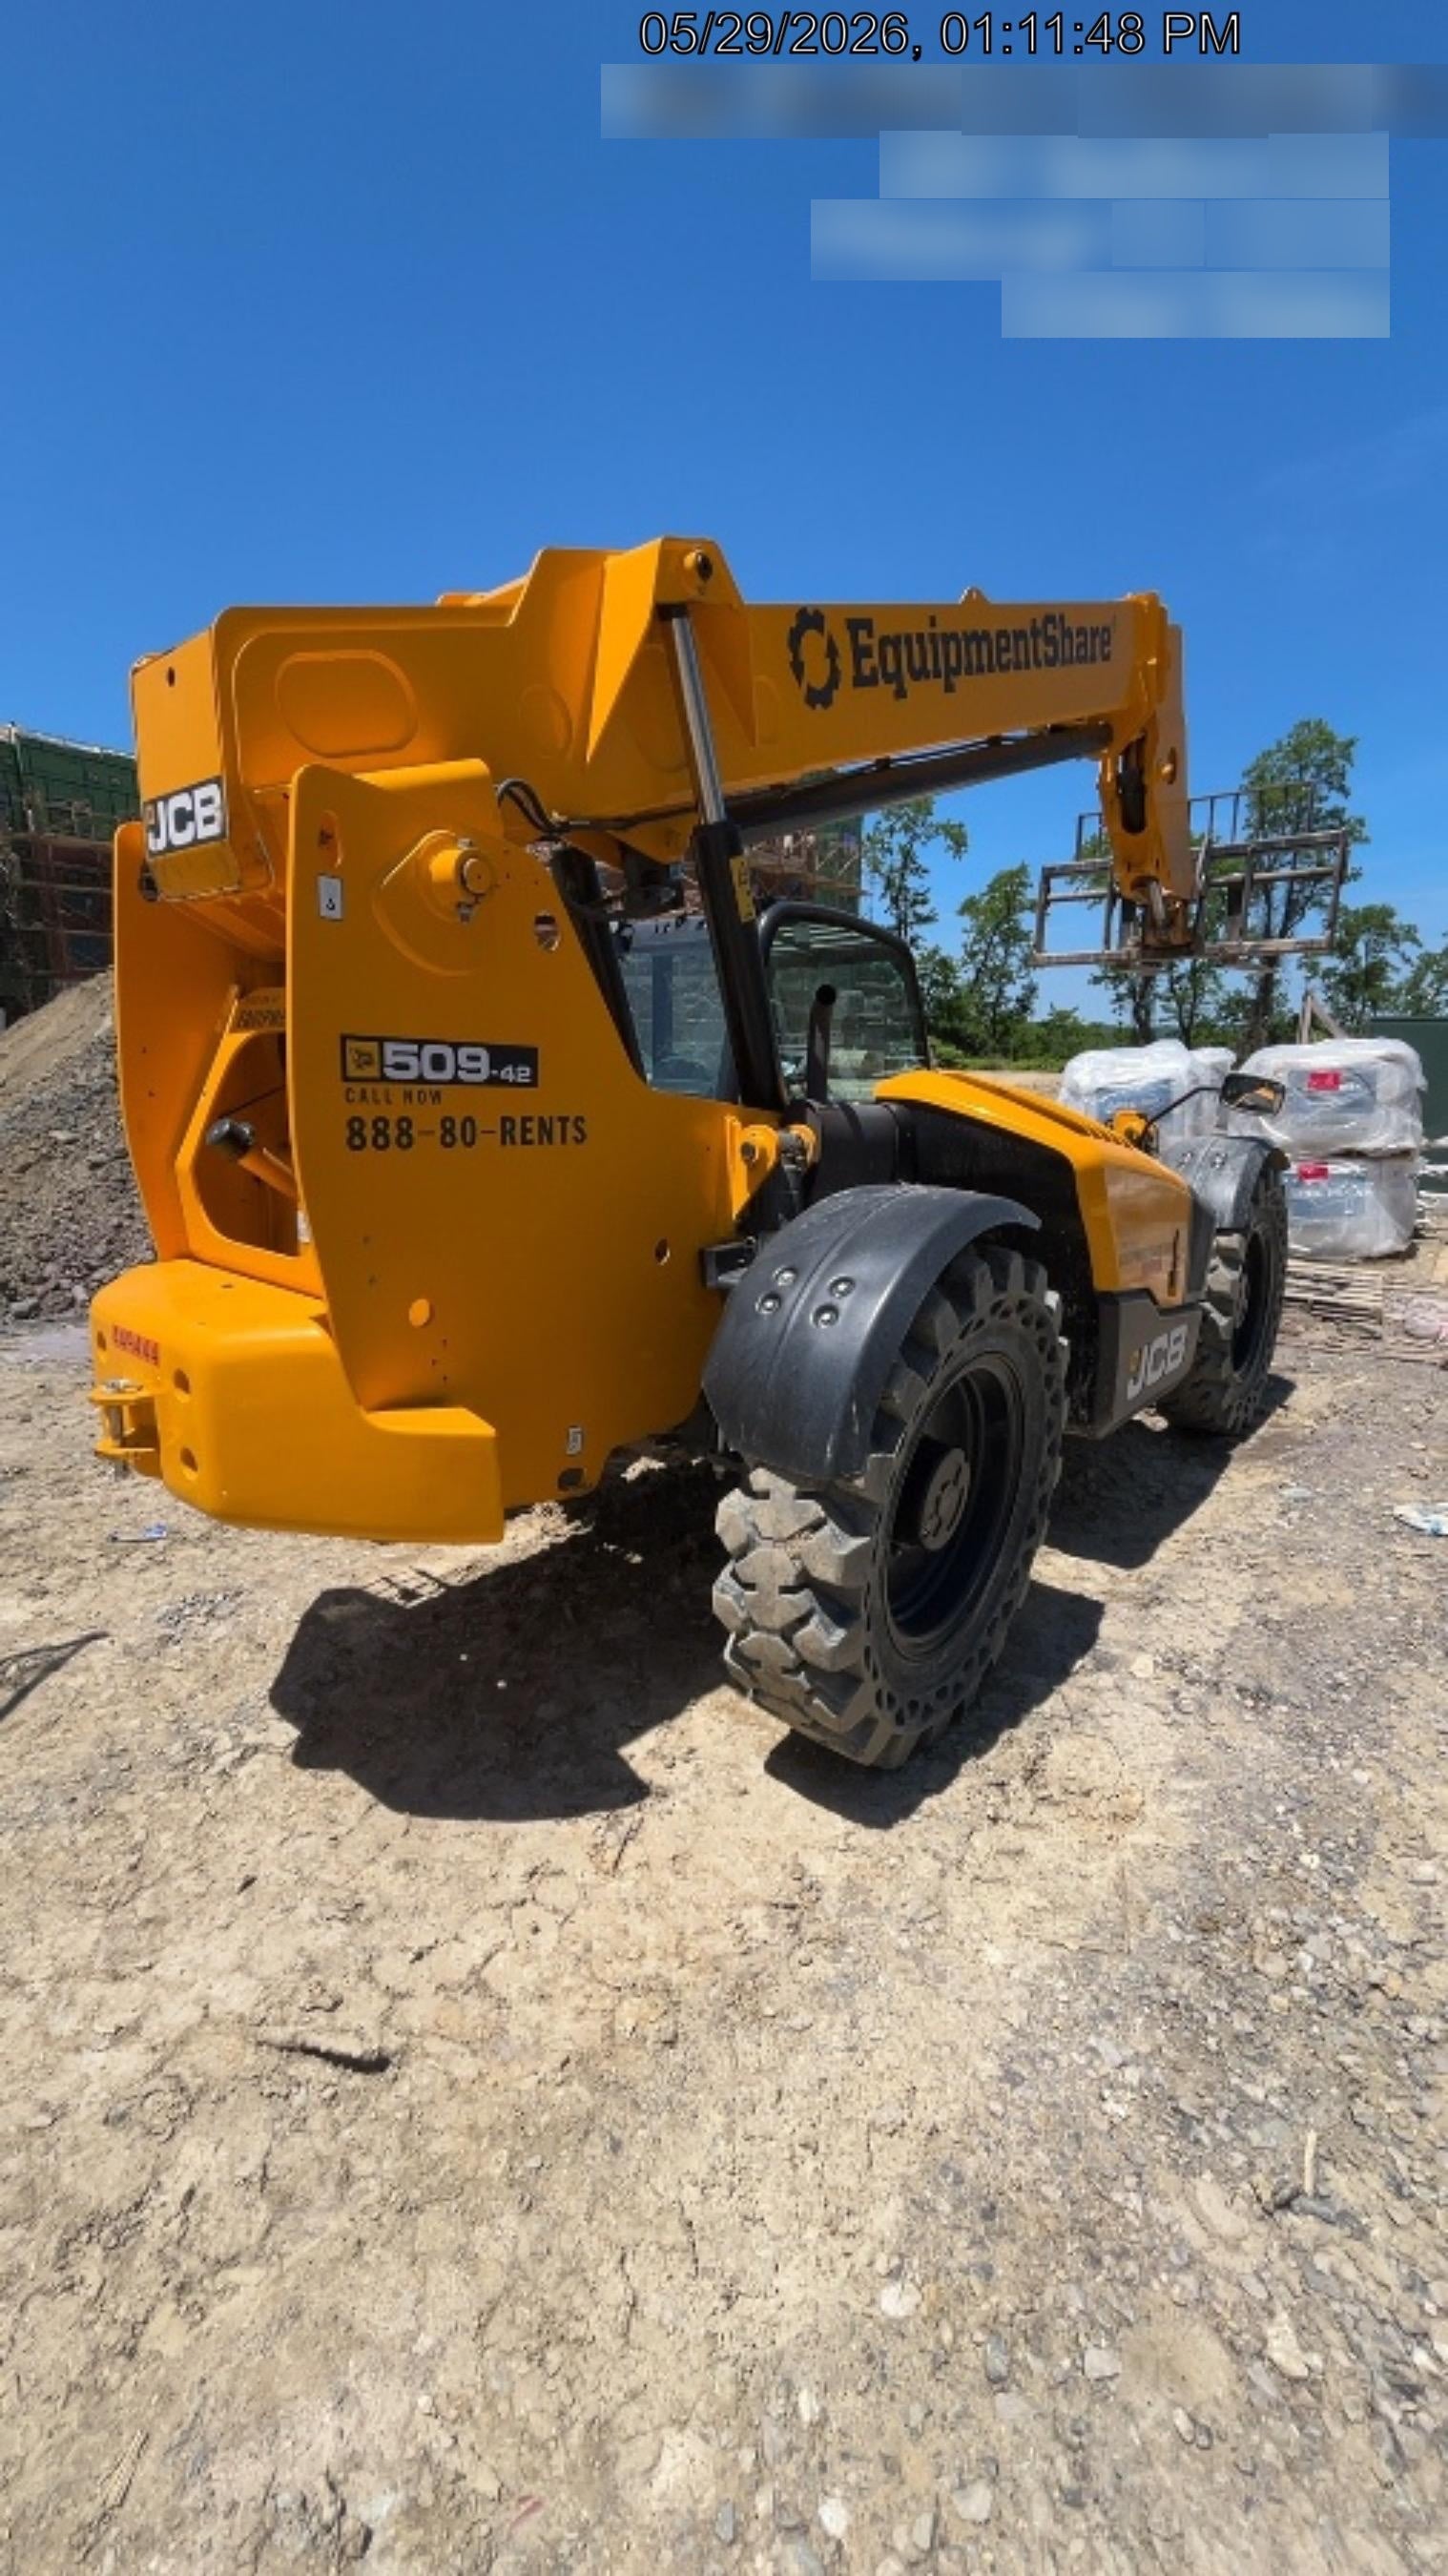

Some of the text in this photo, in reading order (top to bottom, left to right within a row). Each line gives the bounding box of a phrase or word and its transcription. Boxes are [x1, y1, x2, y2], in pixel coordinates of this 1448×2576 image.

[845, 613, 1111, 699] EquipmentShare
[147, 783, 223, 851] JCB
[383, 1041, 532, 1084] 509-42
[345, 1087, 443, 1106] CALL NOW
[346, 1115, 588, 1152] 888-80-RENTS
[1127, 1323, 1189, 1402] JCB
